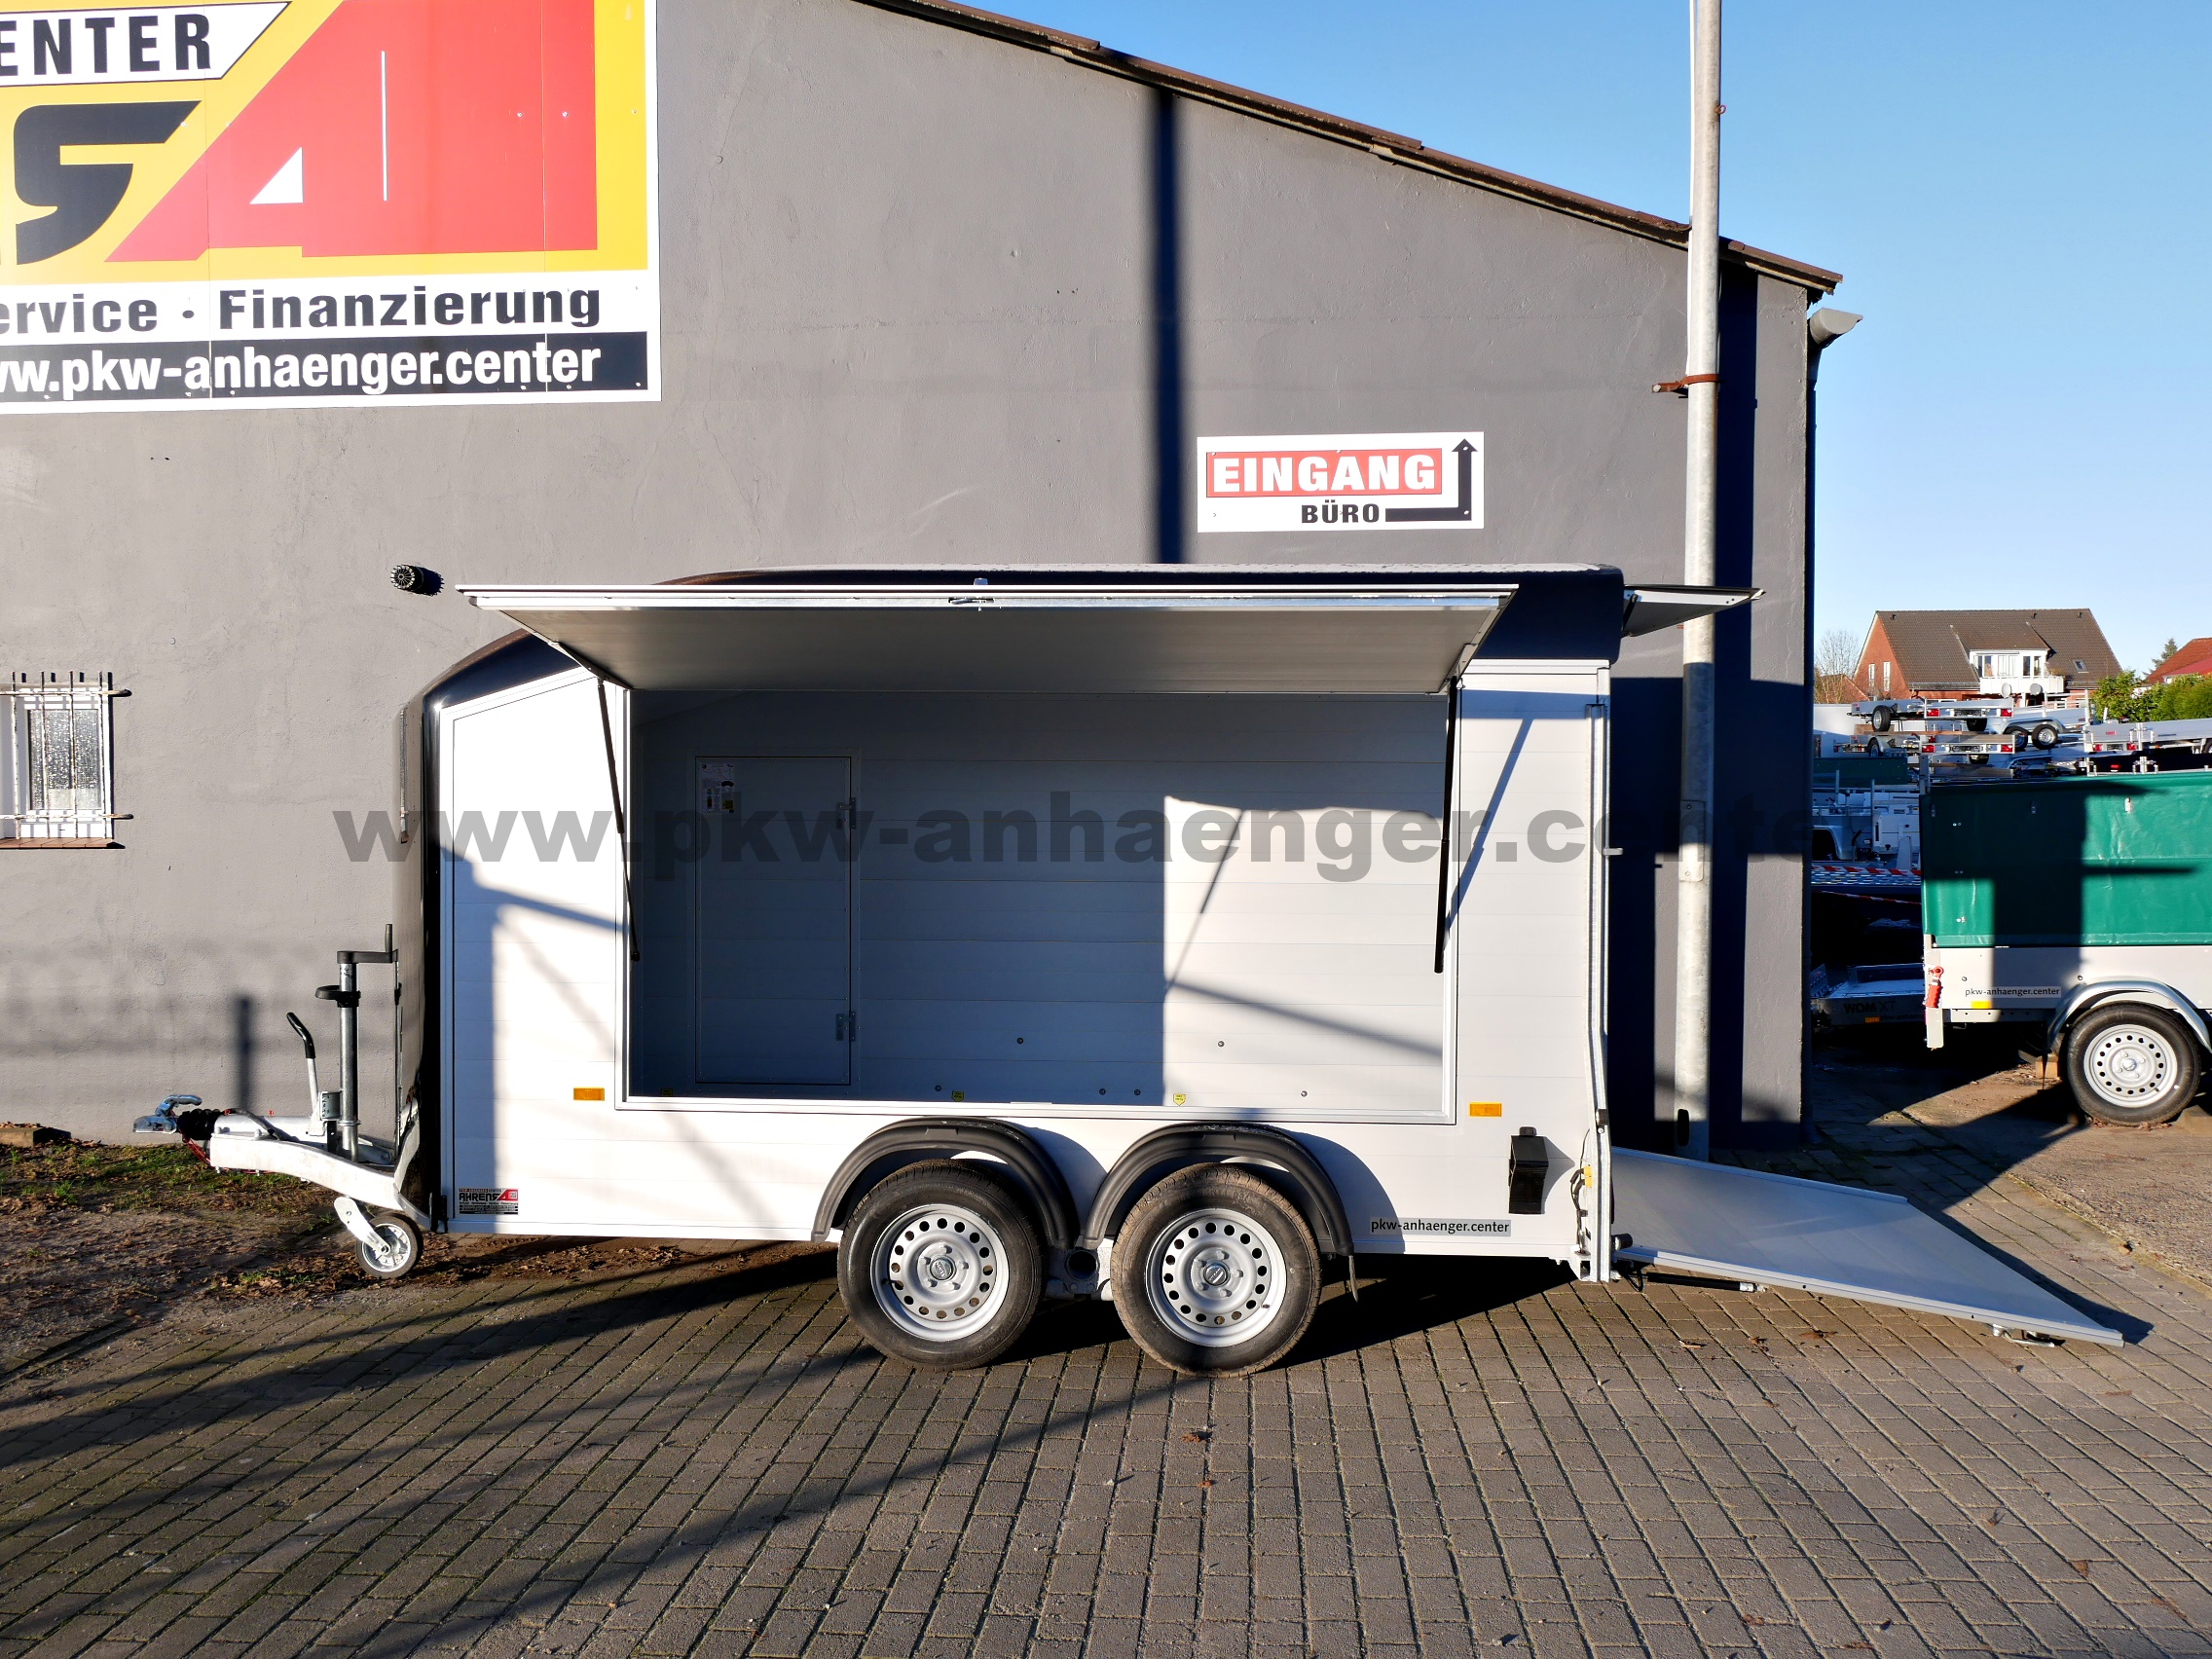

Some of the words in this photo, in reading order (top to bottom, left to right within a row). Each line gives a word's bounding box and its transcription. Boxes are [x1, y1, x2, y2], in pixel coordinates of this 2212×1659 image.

[219, 286, 601, 328] Finanzierung
[0, 342, 602, 401] w.pkw-anhaenger.center
[1213, 454, 1436, 493] EINGANG
[1301, 499, 1381, 524] BÜRO
[1965, 987, 2060, 998] pkw-anhaenger.center
[1371, 1219, 1510, 1235] pkw-anhaenger.center
